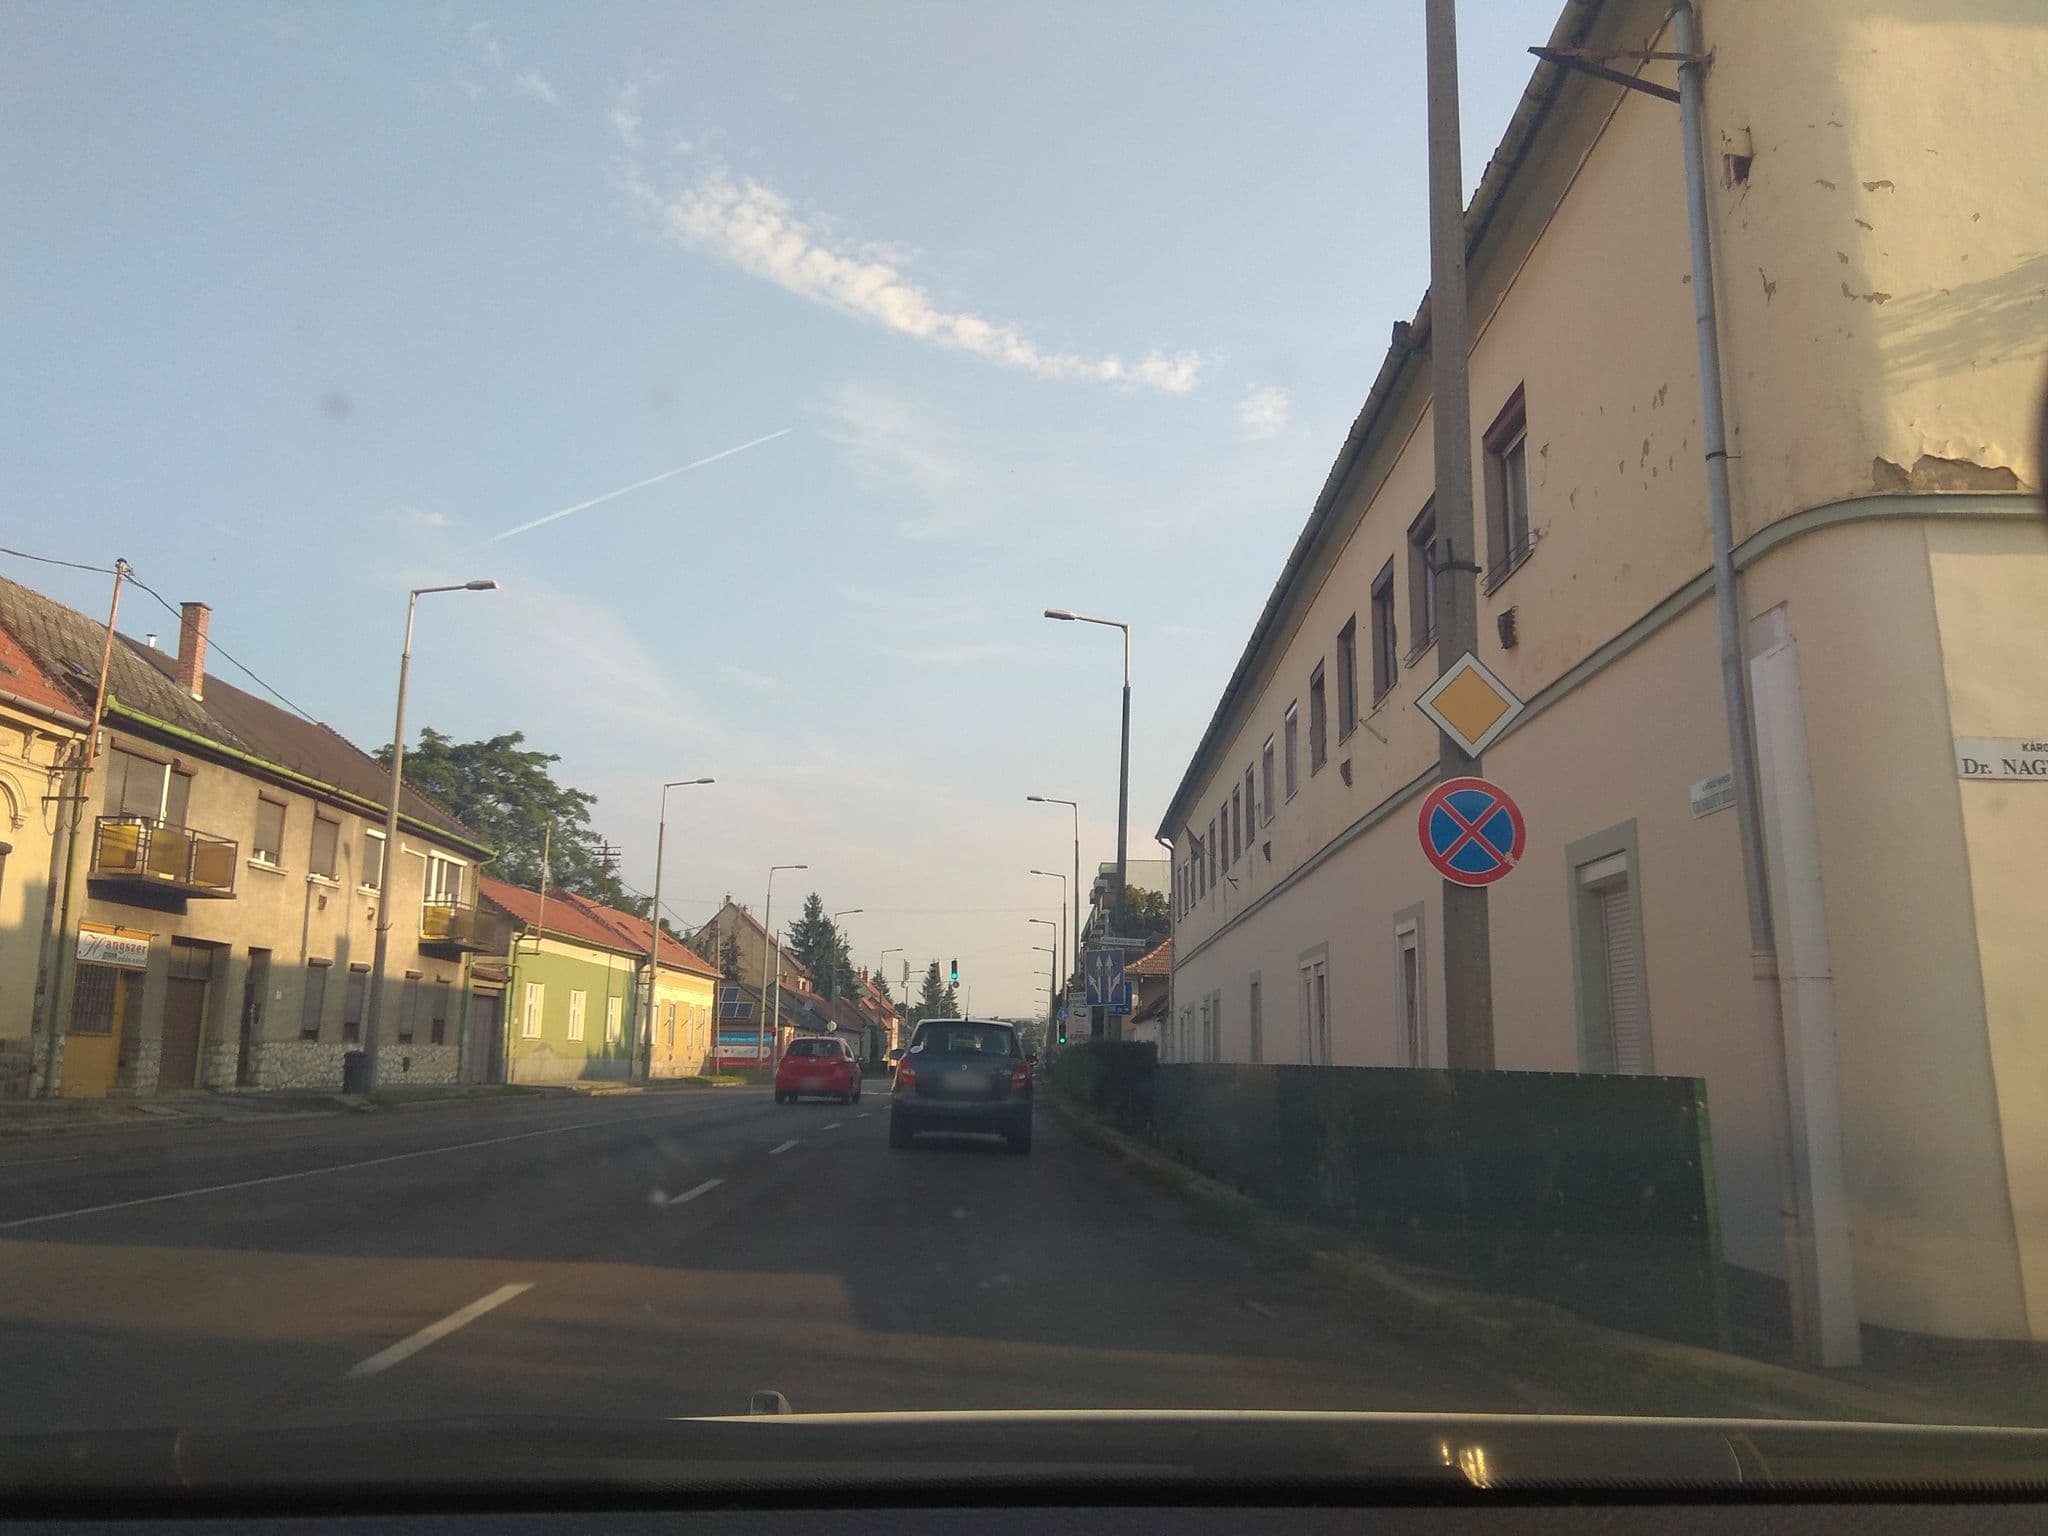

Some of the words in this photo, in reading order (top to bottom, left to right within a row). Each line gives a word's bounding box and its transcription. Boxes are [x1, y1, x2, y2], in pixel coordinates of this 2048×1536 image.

[1961, 758, 1992, 775] Dr.
[2001, 758, 2048, 776] NAG
[78, 934, 147, 957] Hangszer
